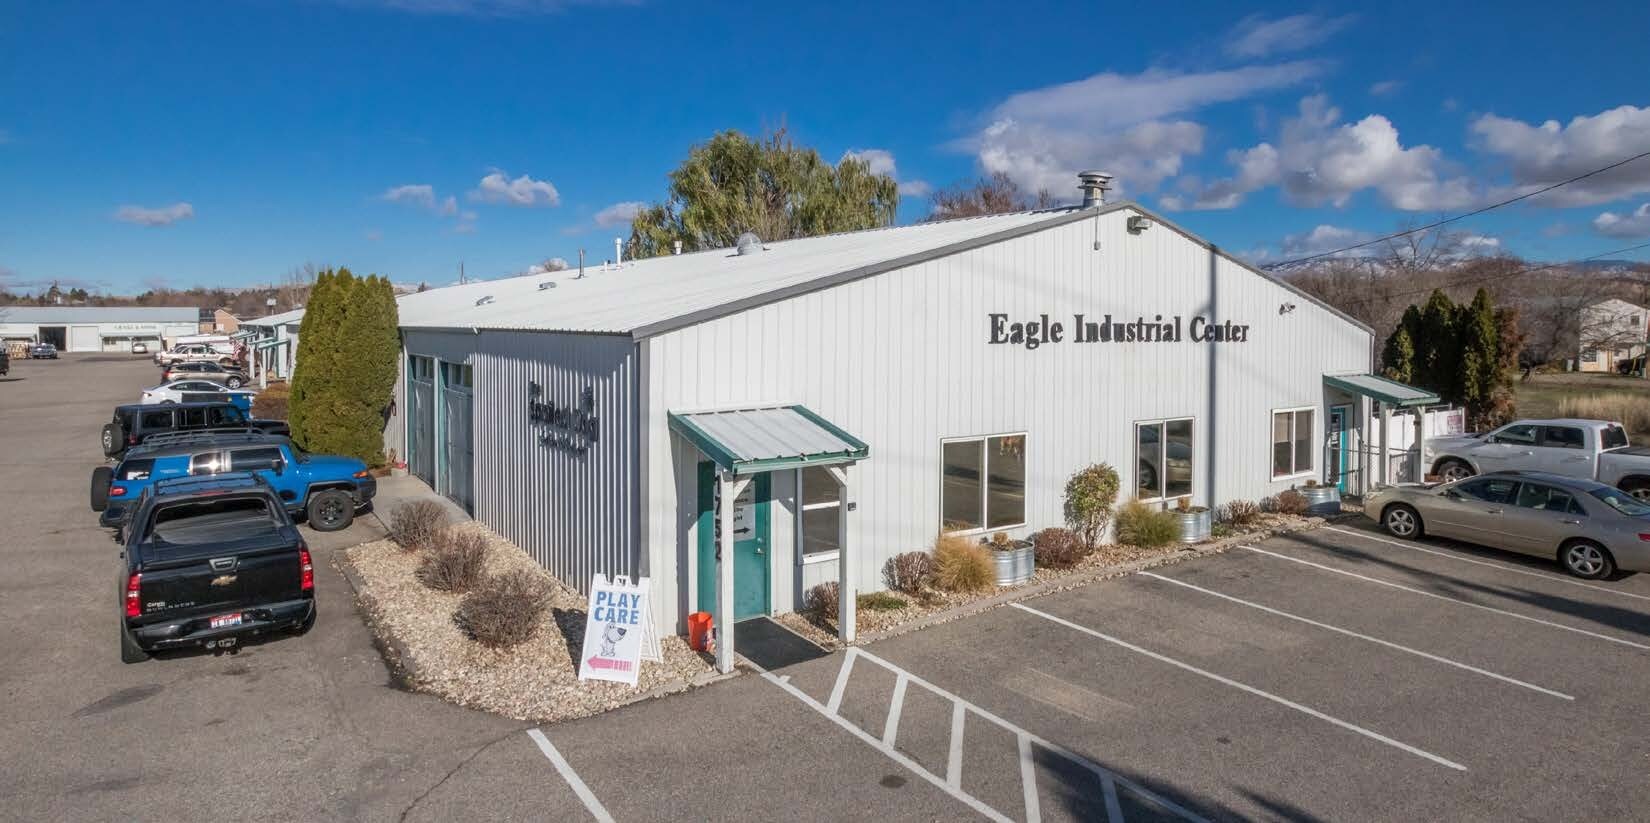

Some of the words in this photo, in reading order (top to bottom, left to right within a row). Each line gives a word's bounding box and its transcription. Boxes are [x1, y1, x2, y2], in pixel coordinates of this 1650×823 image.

[988, 313, 1064, 350] Eagle
[1073, 314, 1182, 343] Industrial
[1189, 316, 1249, 342] Center
[596, 591, 640, 609] PLAY
[594, 607, 640, 625] CARE
